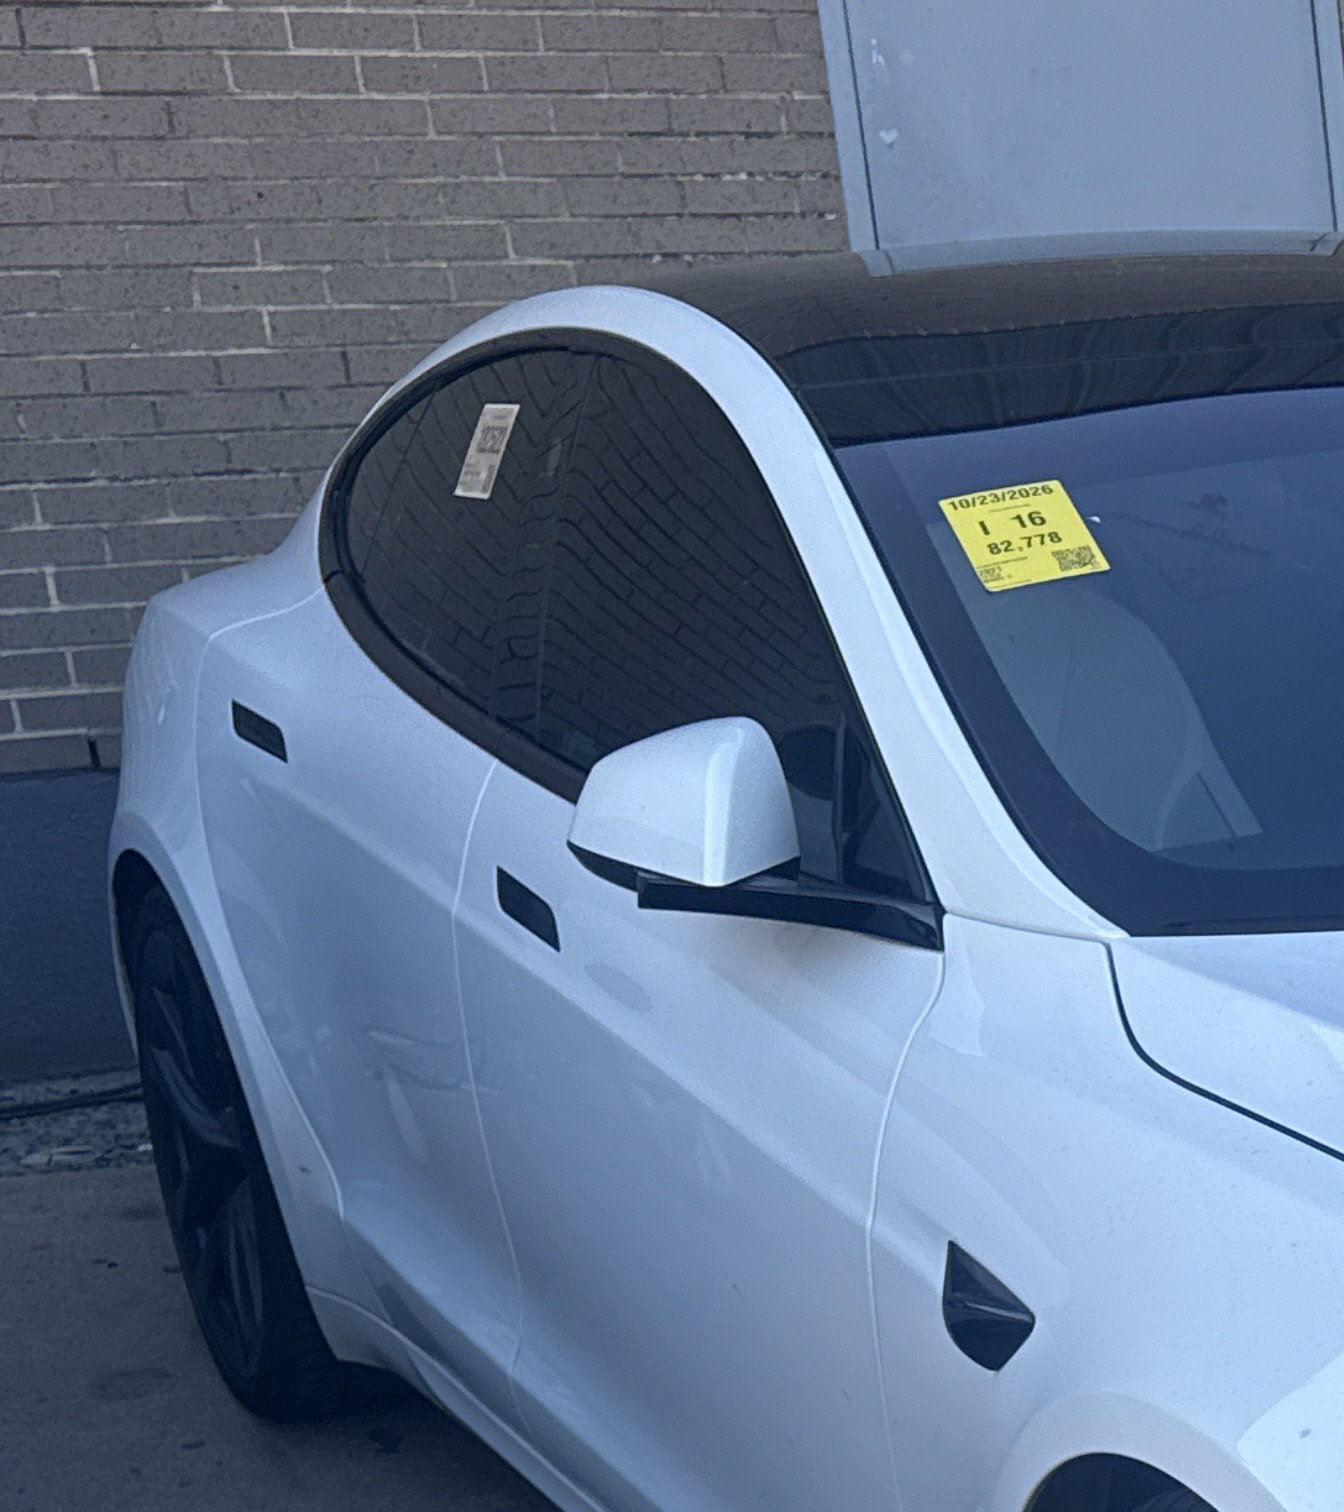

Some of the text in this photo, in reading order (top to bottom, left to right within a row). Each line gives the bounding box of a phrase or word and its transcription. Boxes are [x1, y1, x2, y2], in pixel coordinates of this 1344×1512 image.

[948, 484, 1054, 511] 10/23/2026
[1011, 510, 1047, 529] 16
[987, 531, 1063, 555] 82,778
